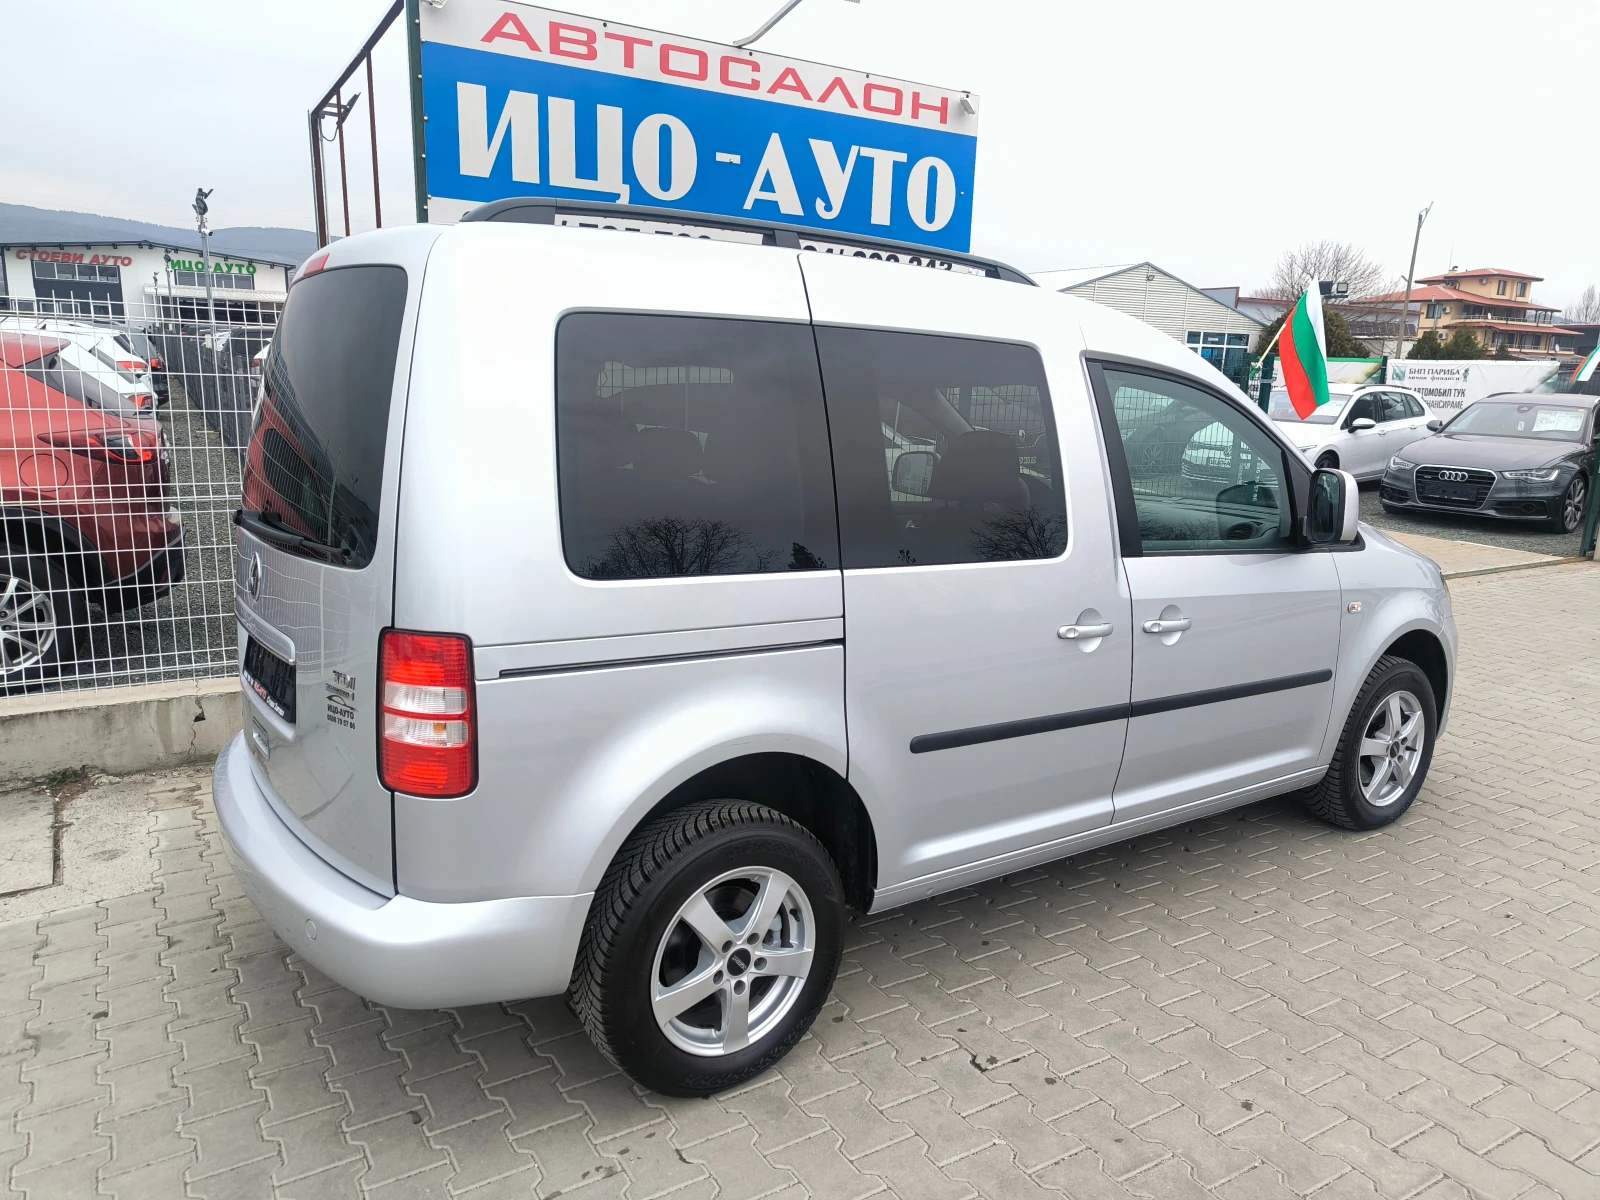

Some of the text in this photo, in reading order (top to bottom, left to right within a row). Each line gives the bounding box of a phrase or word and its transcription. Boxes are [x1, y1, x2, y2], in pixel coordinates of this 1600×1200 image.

[480, 12, 949, 125] АВТОСАЛОН
[16, 249, 132, 267] СТОЕВИ АУТО
[1427, 368, 1460, 376] ПАРИБА
[1453, 388, 1466, 398] ТУК
[327, 703, 354, 720] ИЦО-АУТО
